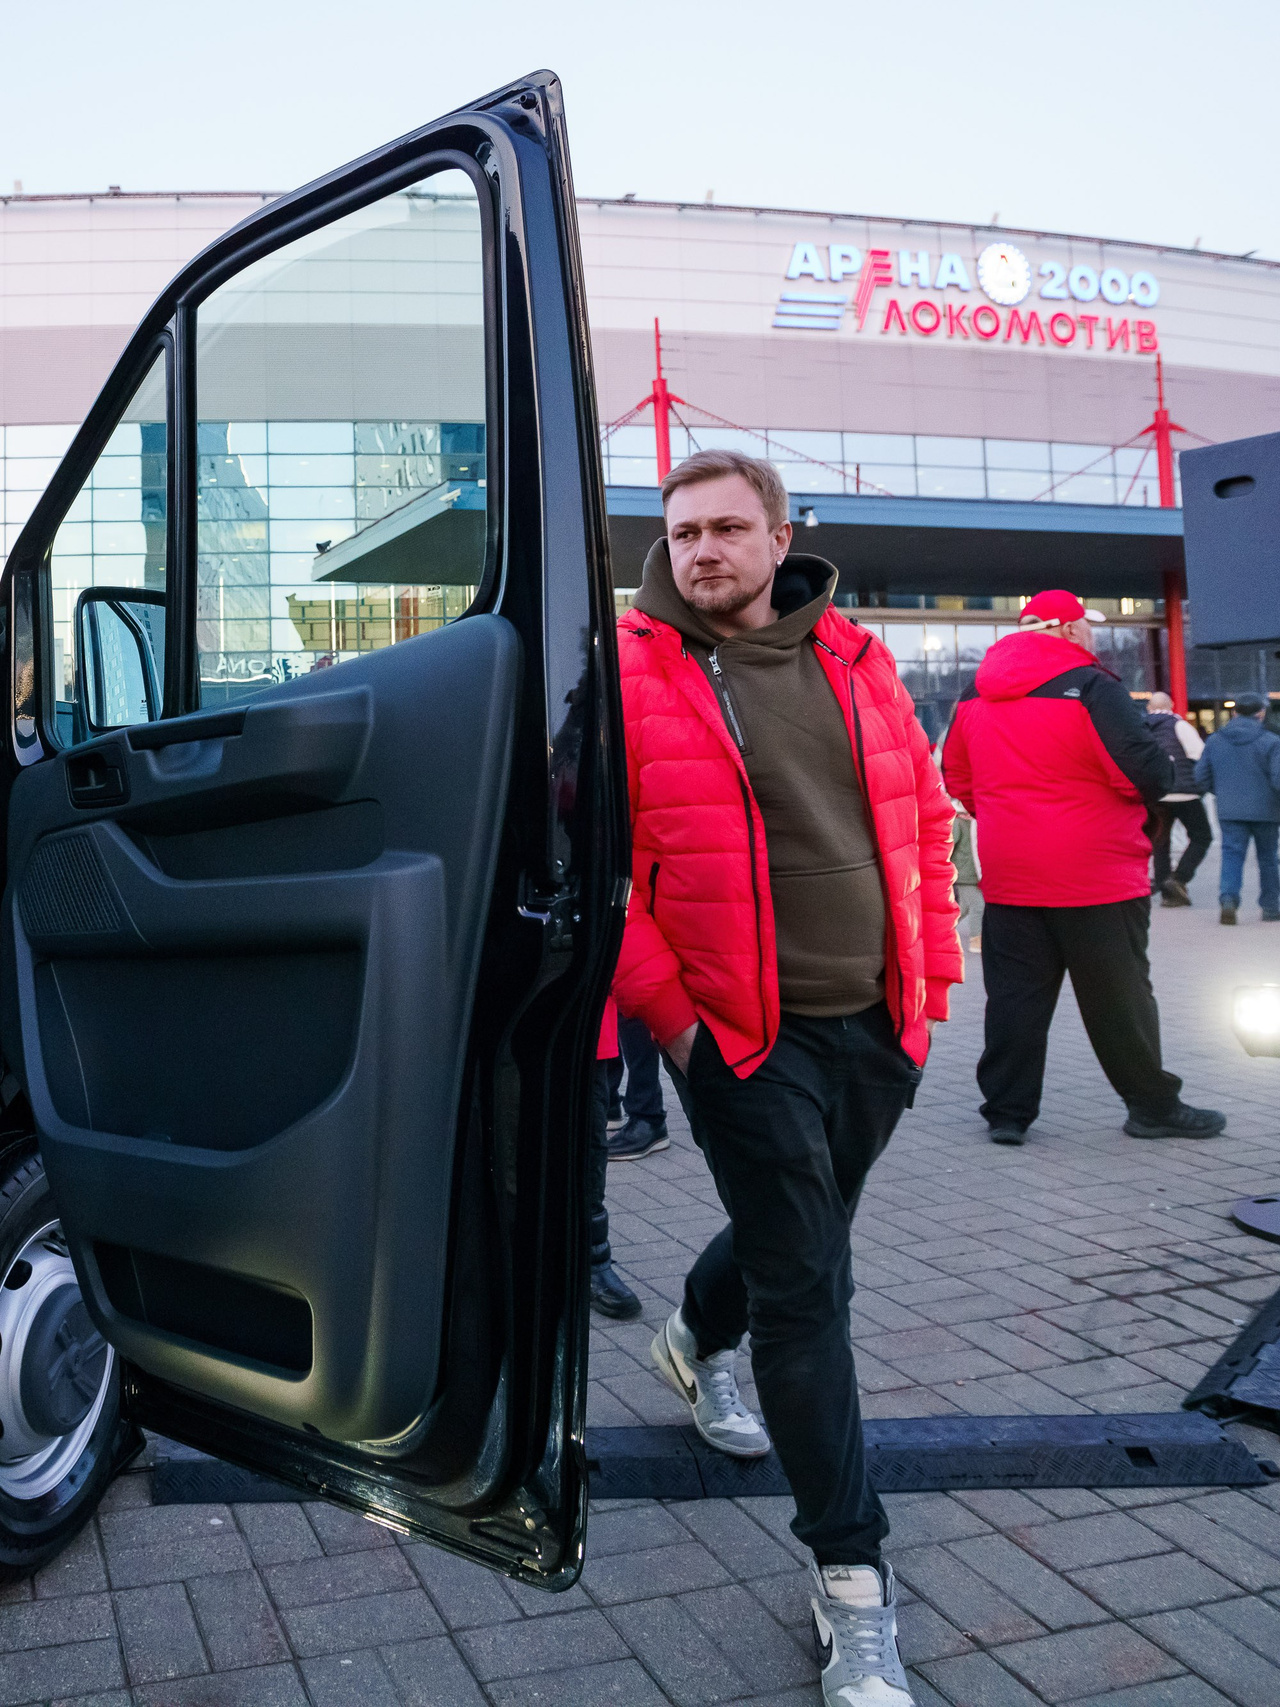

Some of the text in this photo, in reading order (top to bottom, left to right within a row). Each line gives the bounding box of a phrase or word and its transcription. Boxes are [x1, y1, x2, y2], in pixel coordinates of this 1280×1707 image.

[786, 241, 1160, 331] АРЕНА 2000
[881, 299, 1158, 353] ЛОКОМОТИВ
